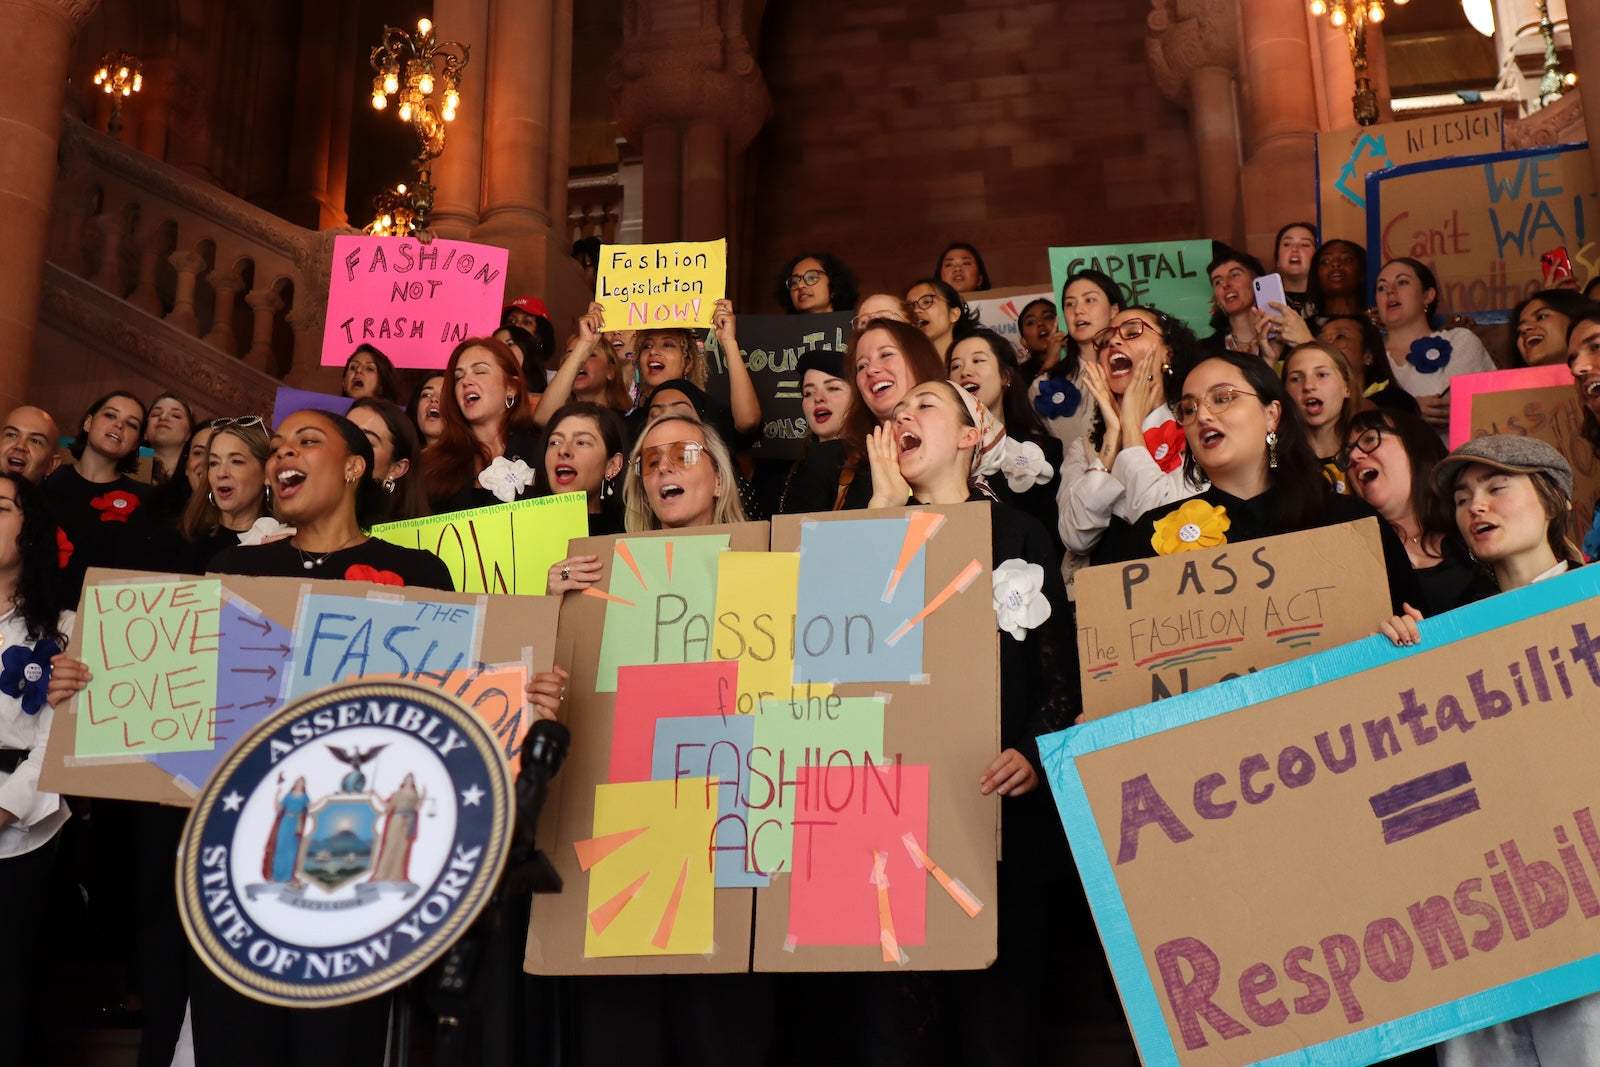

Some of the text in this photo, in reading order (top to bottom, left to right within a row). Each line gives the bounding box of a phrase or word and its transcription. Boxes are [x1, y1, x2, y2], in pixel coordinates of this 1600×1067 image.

[1484, 153, 1563, 203] WE
[612, 249, 707, 269] Fashion
[1383, 209, 1470, 259] Can't
[346, 243, 499, 285] FASHION
[602, 276, 703, 302] Legislation
[1067, 251, 1197, 280] CAPITAL
[391, 280, 442, 302] NOT
[628, 298, 701, 325] NOW!
[341, 317, 424, 343] TRASH
[95, 584, 202, 614] LOVE
[1122, 546, 1276, 610] PASS
[415, 601, 470, 624] THE
[1079, 586, 1336, 664] The FASHION ACT
[100, 608, 226, 671] LOVE
[88, 666, 206, 725] LOVE
[303, 612, 522, 760] FASHION
[718, 676, 842, 729] for the
[124, 704, 236, 748] LOVE
[268, 700, 469, 764] ASSEMBLY
[673, 740, 903, 817] FASHION
[708, 813, 837, 881] ACT
[202, 844, 482, 979] STATE OF NEW YORK
